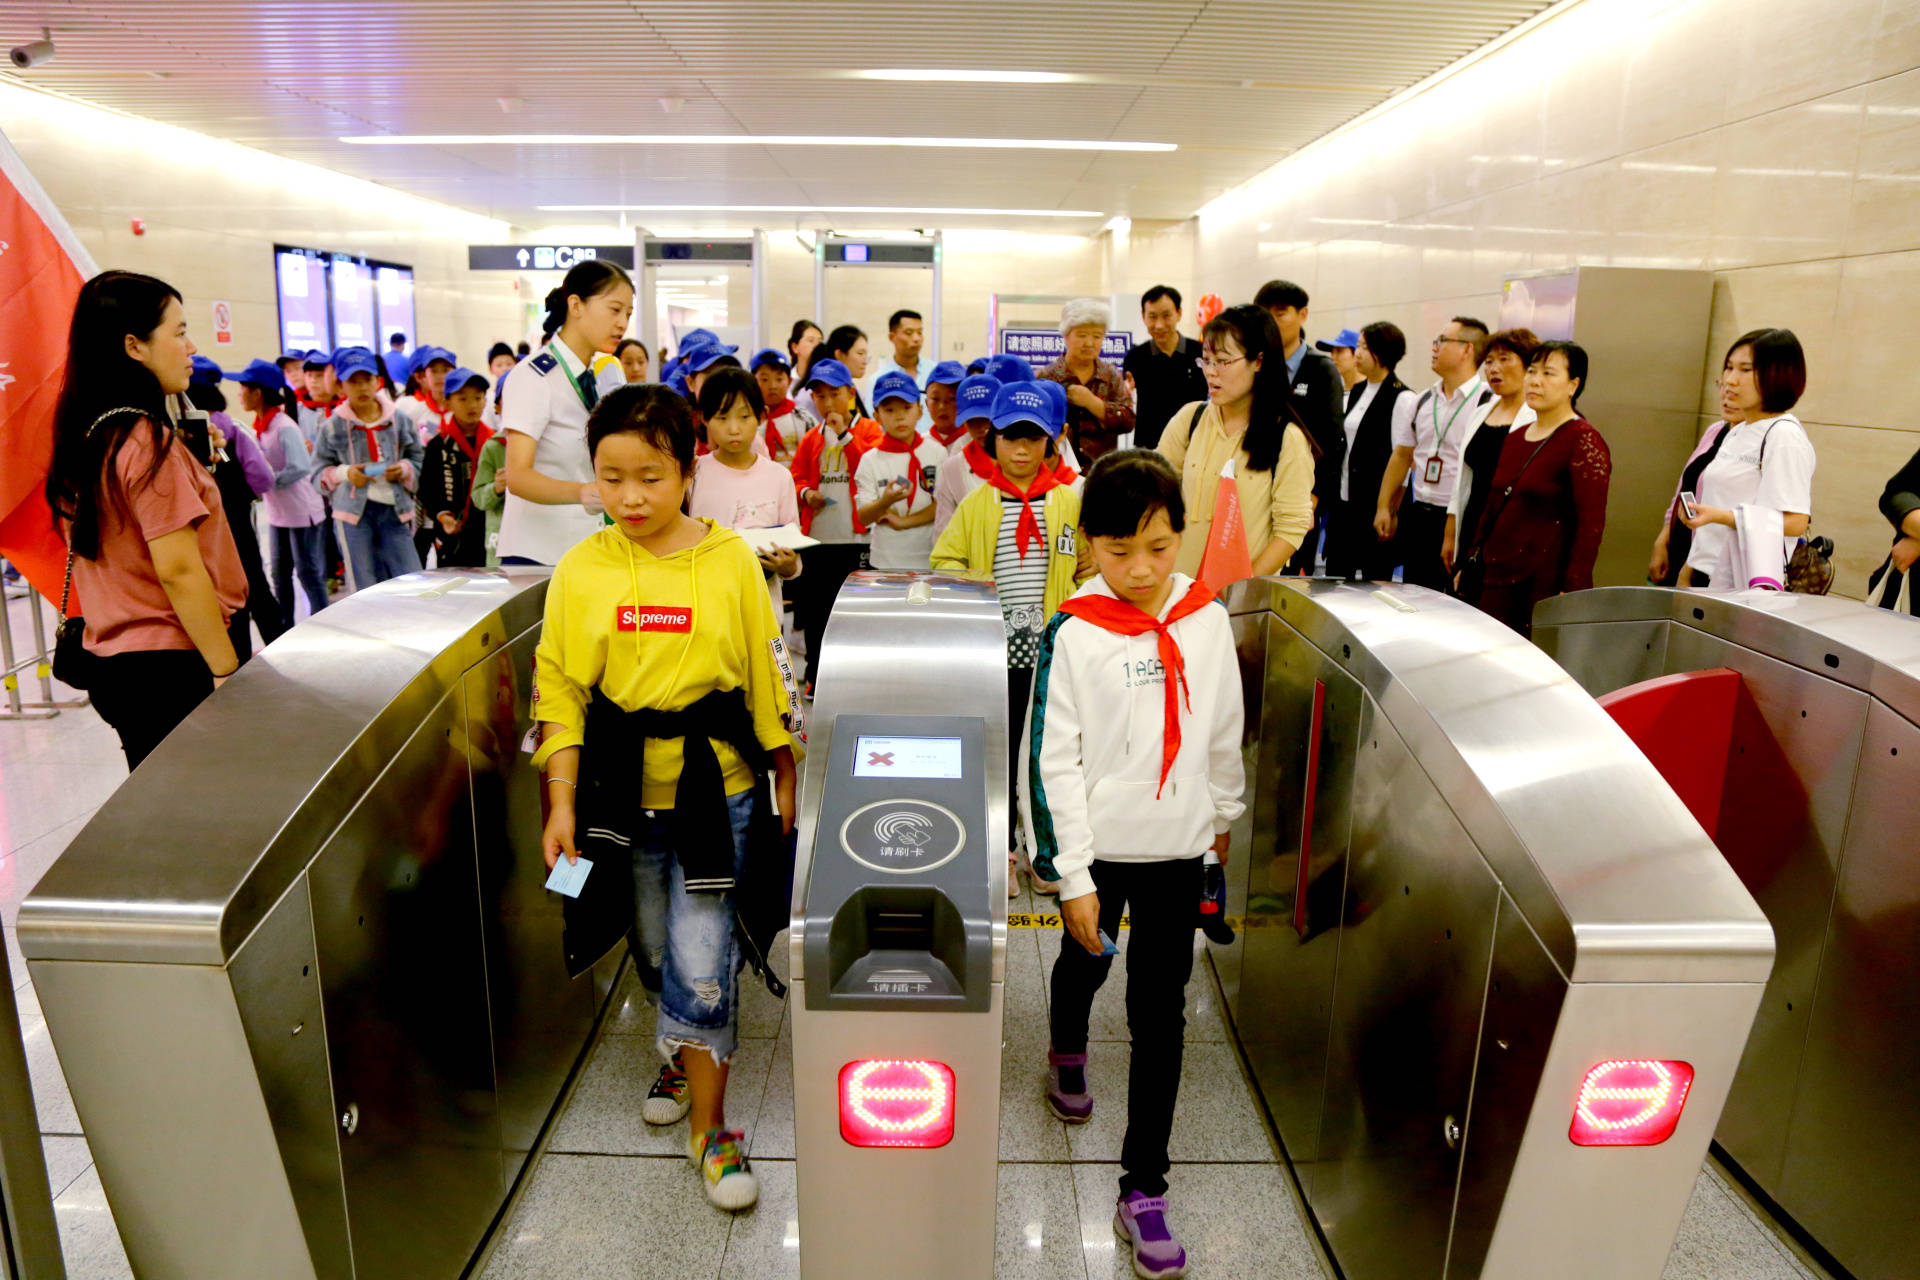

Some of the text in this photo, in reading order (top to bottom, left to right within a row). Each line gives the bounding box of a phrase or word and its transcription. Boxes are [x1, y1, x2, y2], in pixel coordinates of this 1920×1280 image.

[622, 611, 687, 627] Supreme
[880, 846, 925, 857] 请刷卡
[873, 983, 929, 993] 请插卡
